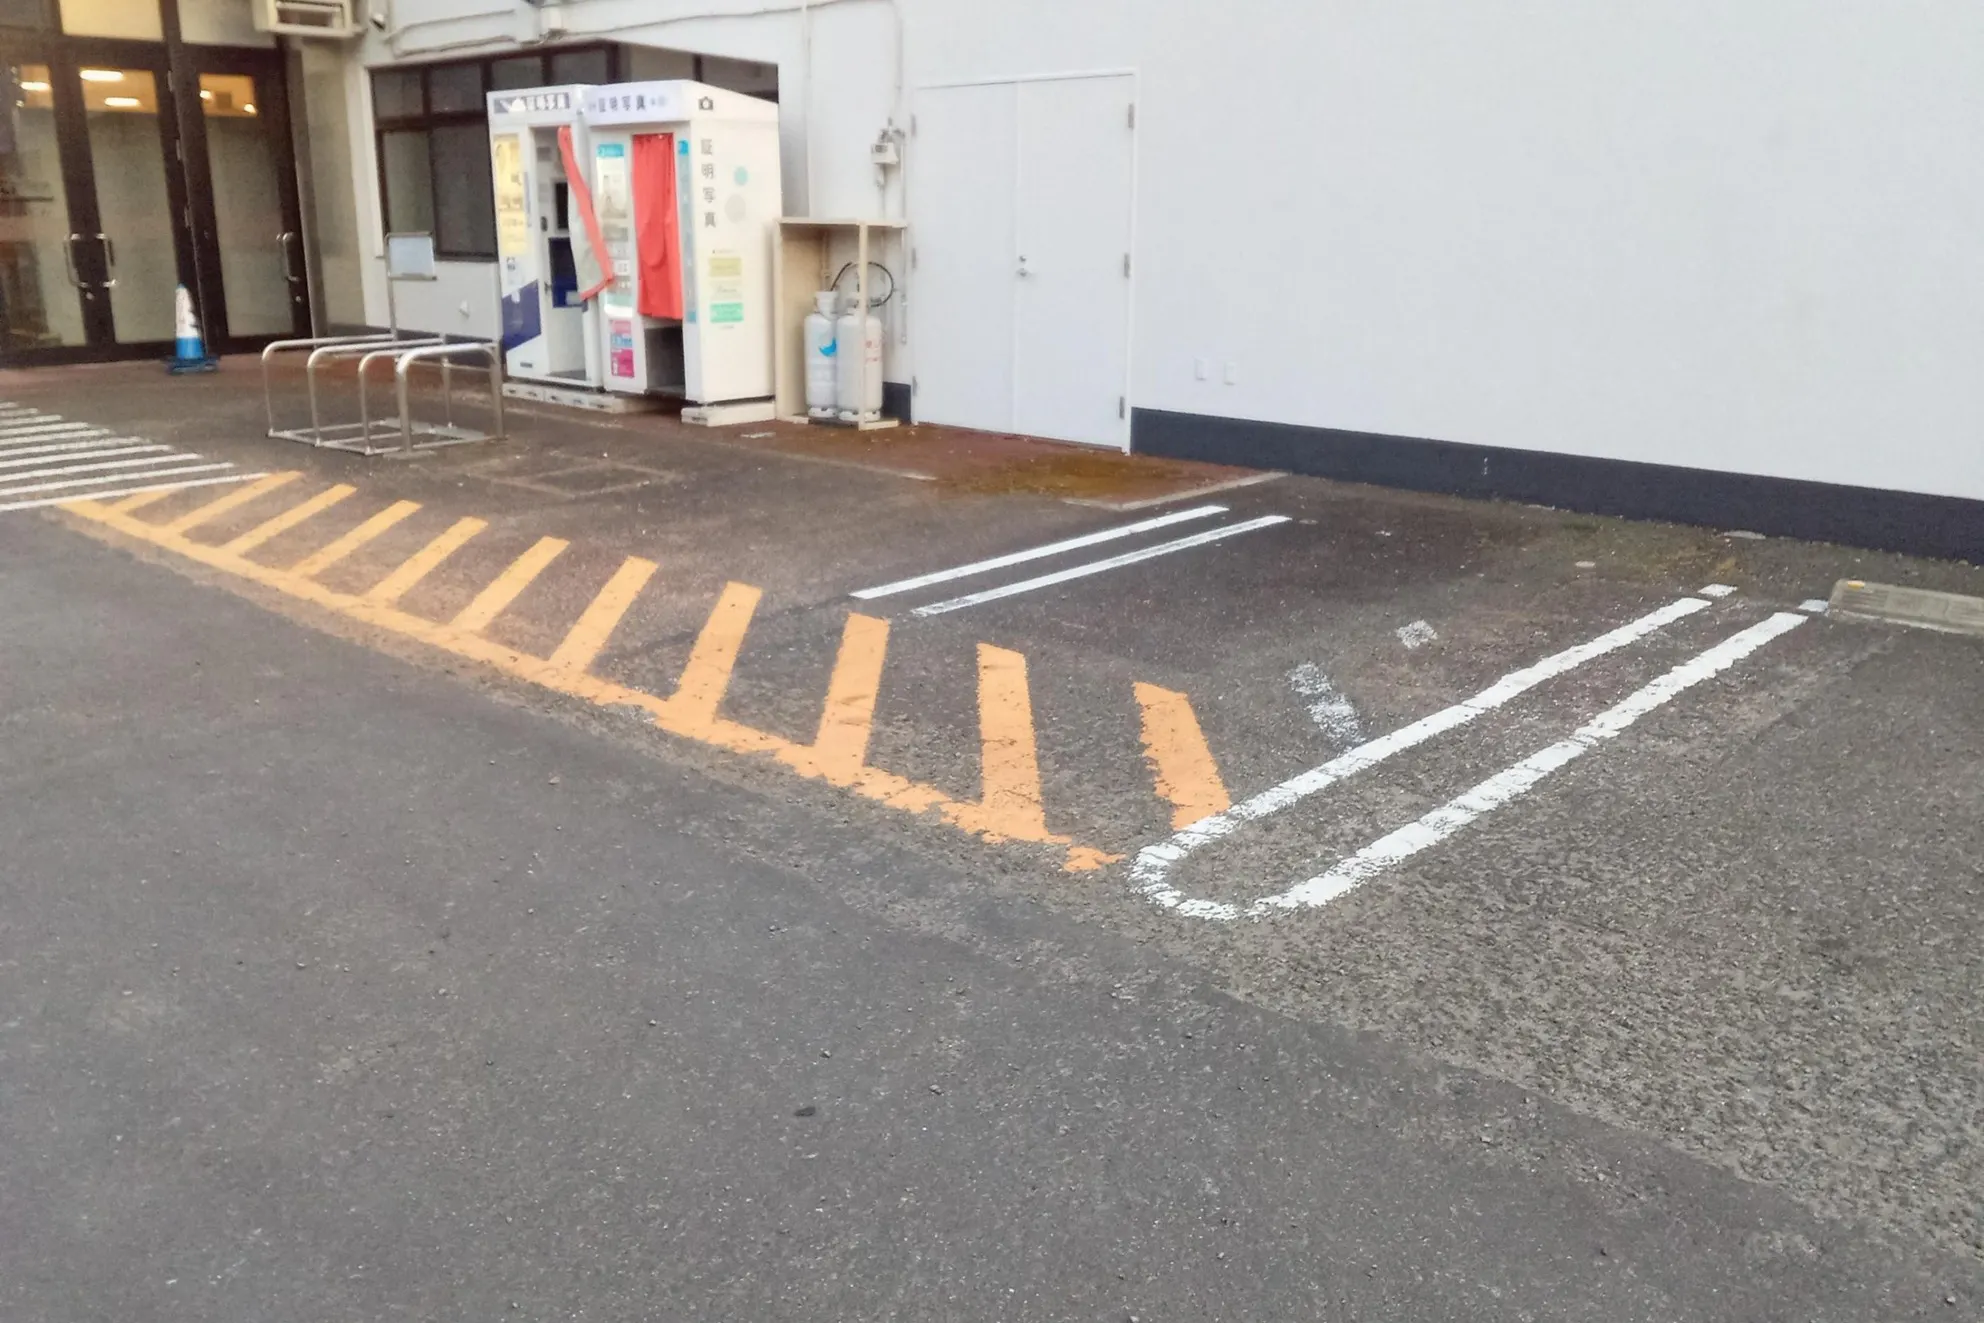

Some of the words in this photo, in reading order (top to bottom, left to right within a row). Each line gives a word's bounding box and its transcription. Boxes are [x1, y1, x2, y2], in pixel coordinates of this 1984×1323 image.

[599, 95, 646, 113] 証明写真
[700, 137, 716, 229] 証明写真
